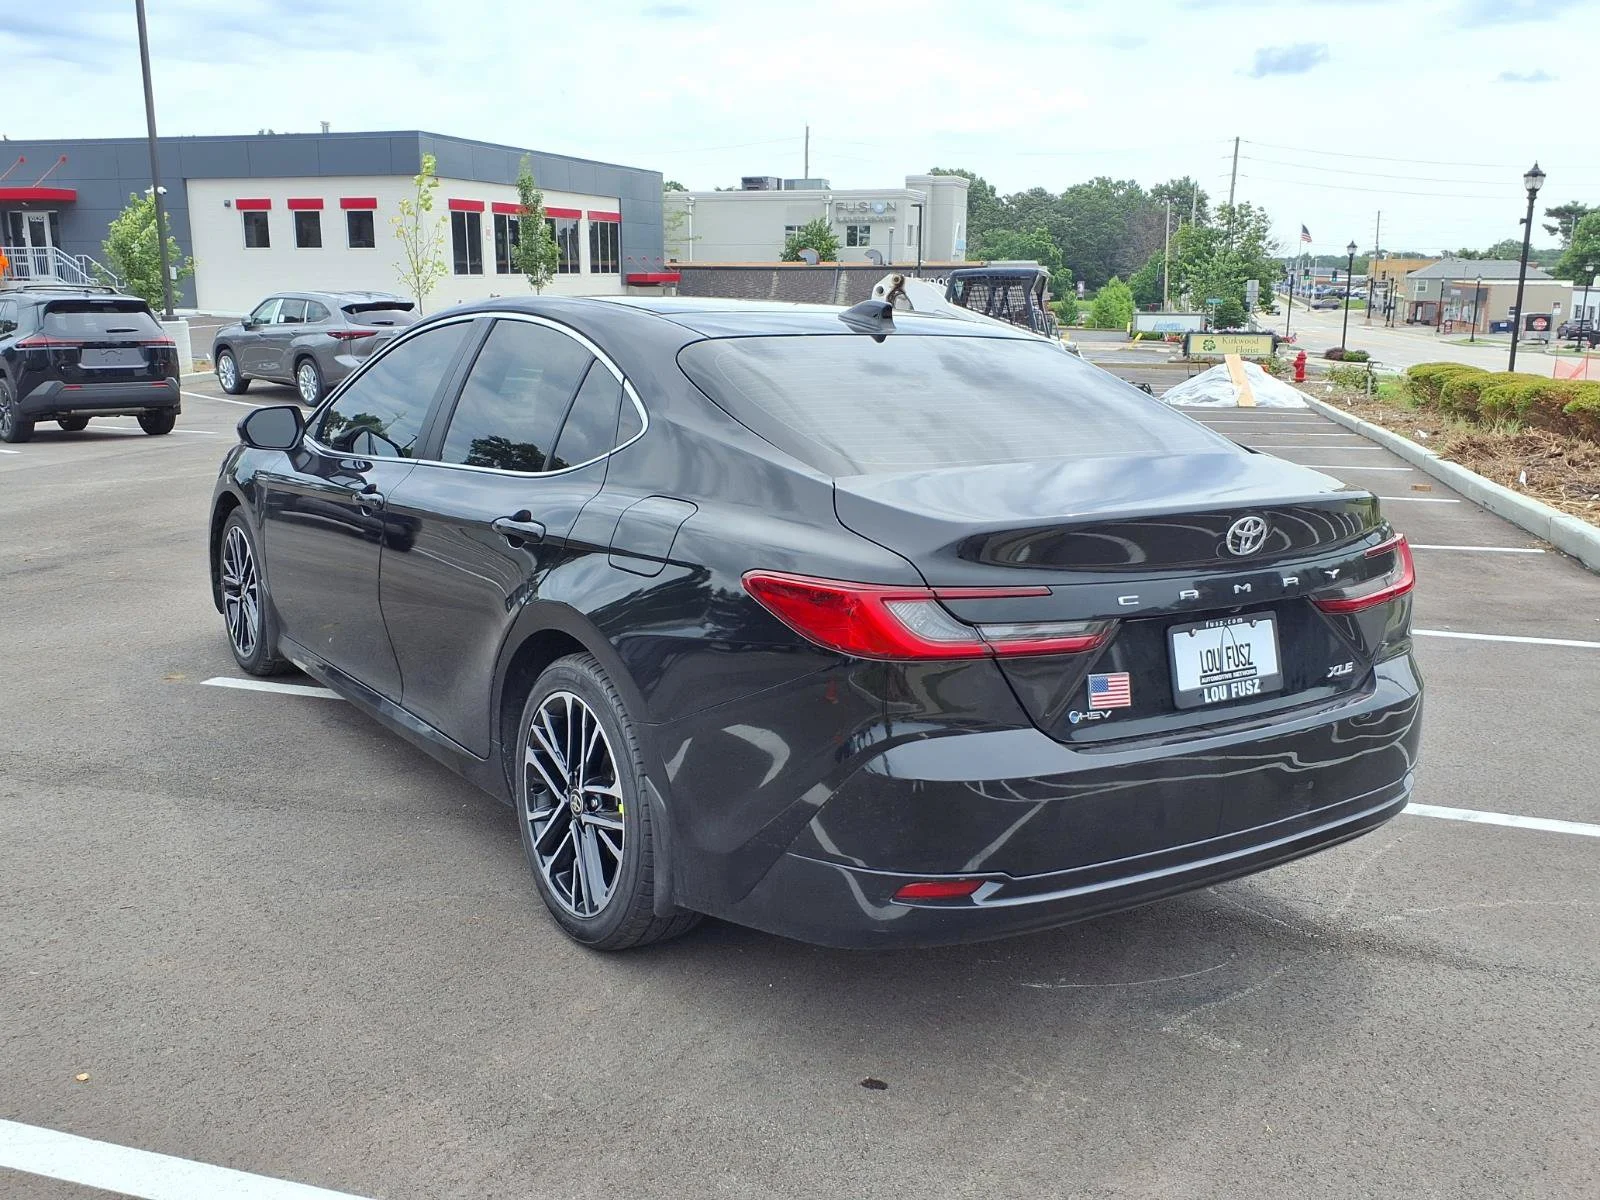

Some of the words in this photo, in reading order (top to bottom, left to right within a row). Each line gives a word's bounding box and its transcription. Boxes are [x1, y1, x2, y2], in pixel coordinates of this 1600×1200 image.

[836, 200, 896, 215] FUSION
[1222, 337, 1259, 345] Kirkwood
[1235, 346, 1259, 354] Florist
[1117, 568, 1340, 606] CAMRY
[1205, 618, 1243, 628] fusz.com
[1199, 647, 1220, 673] LOU
[1225, 643, 1253, 669] FUSZ
[1326, 661, 1354, 678] XLE
[1204, 685, 1227, 703] LOU
[1230, 678, 1261, 698] FUSZ
[1078, 710, 1113, 721] HEV
